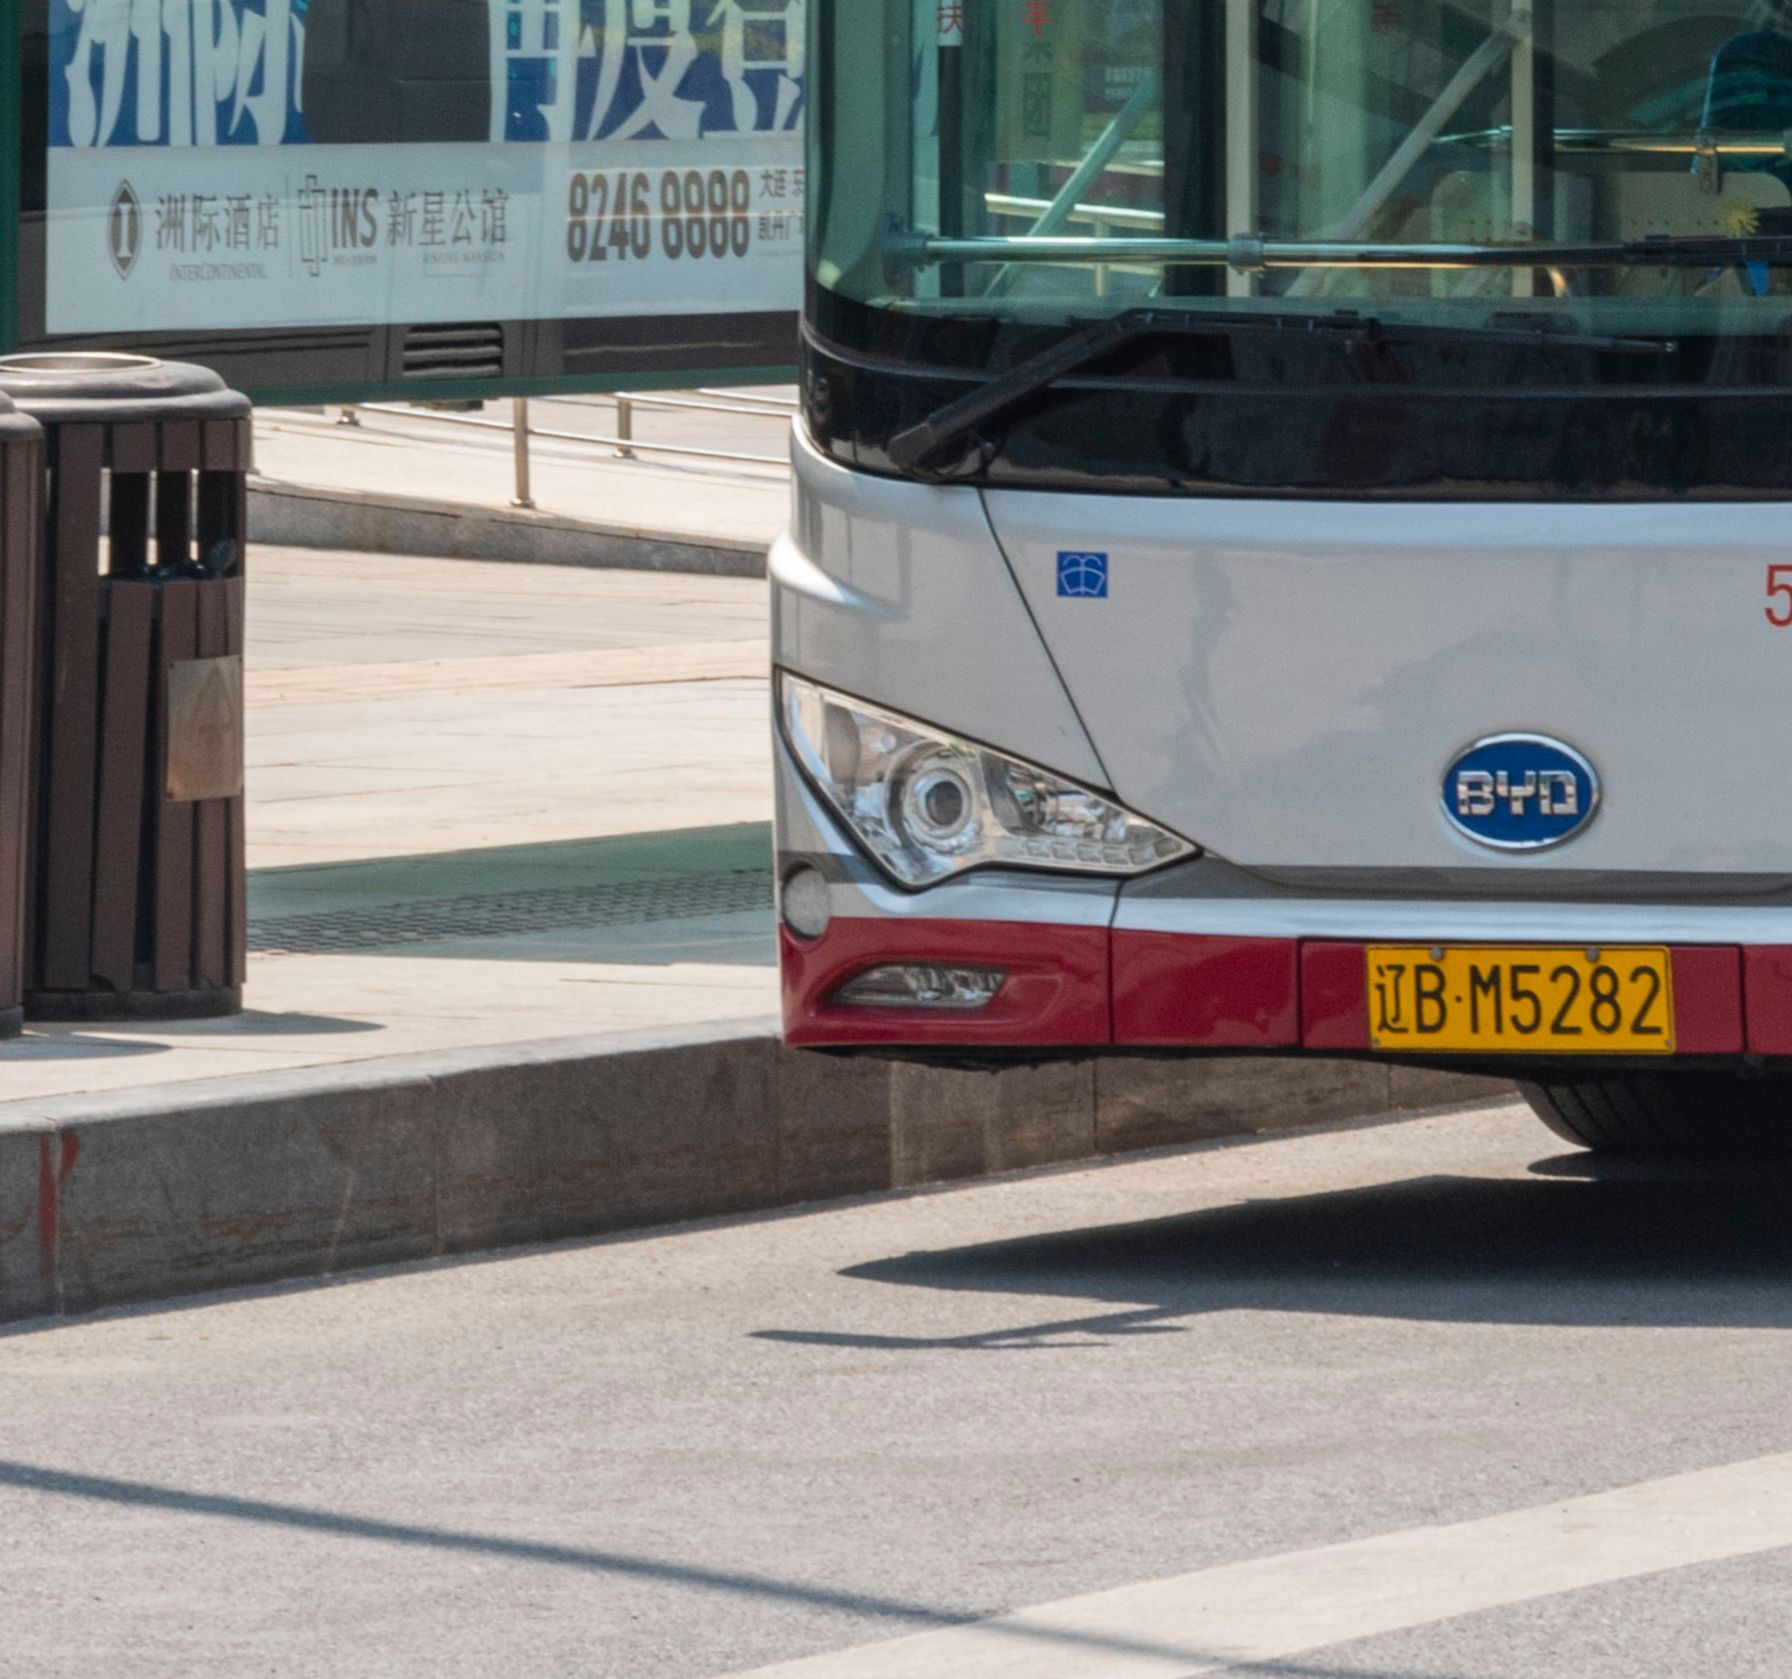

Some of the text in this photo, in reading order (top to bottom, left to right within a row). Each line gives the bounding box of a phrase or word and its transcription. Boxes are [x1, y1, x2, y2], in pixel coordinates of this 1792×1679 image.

[155, 192, 280, 253] 洲际酒店
[331, 188, 379, 249] INS
[386, 187, 509, 248] 新星公馆
[567, 169, 750, 263] 8246 8888
[1456, 769, 1578, 816] BYD
